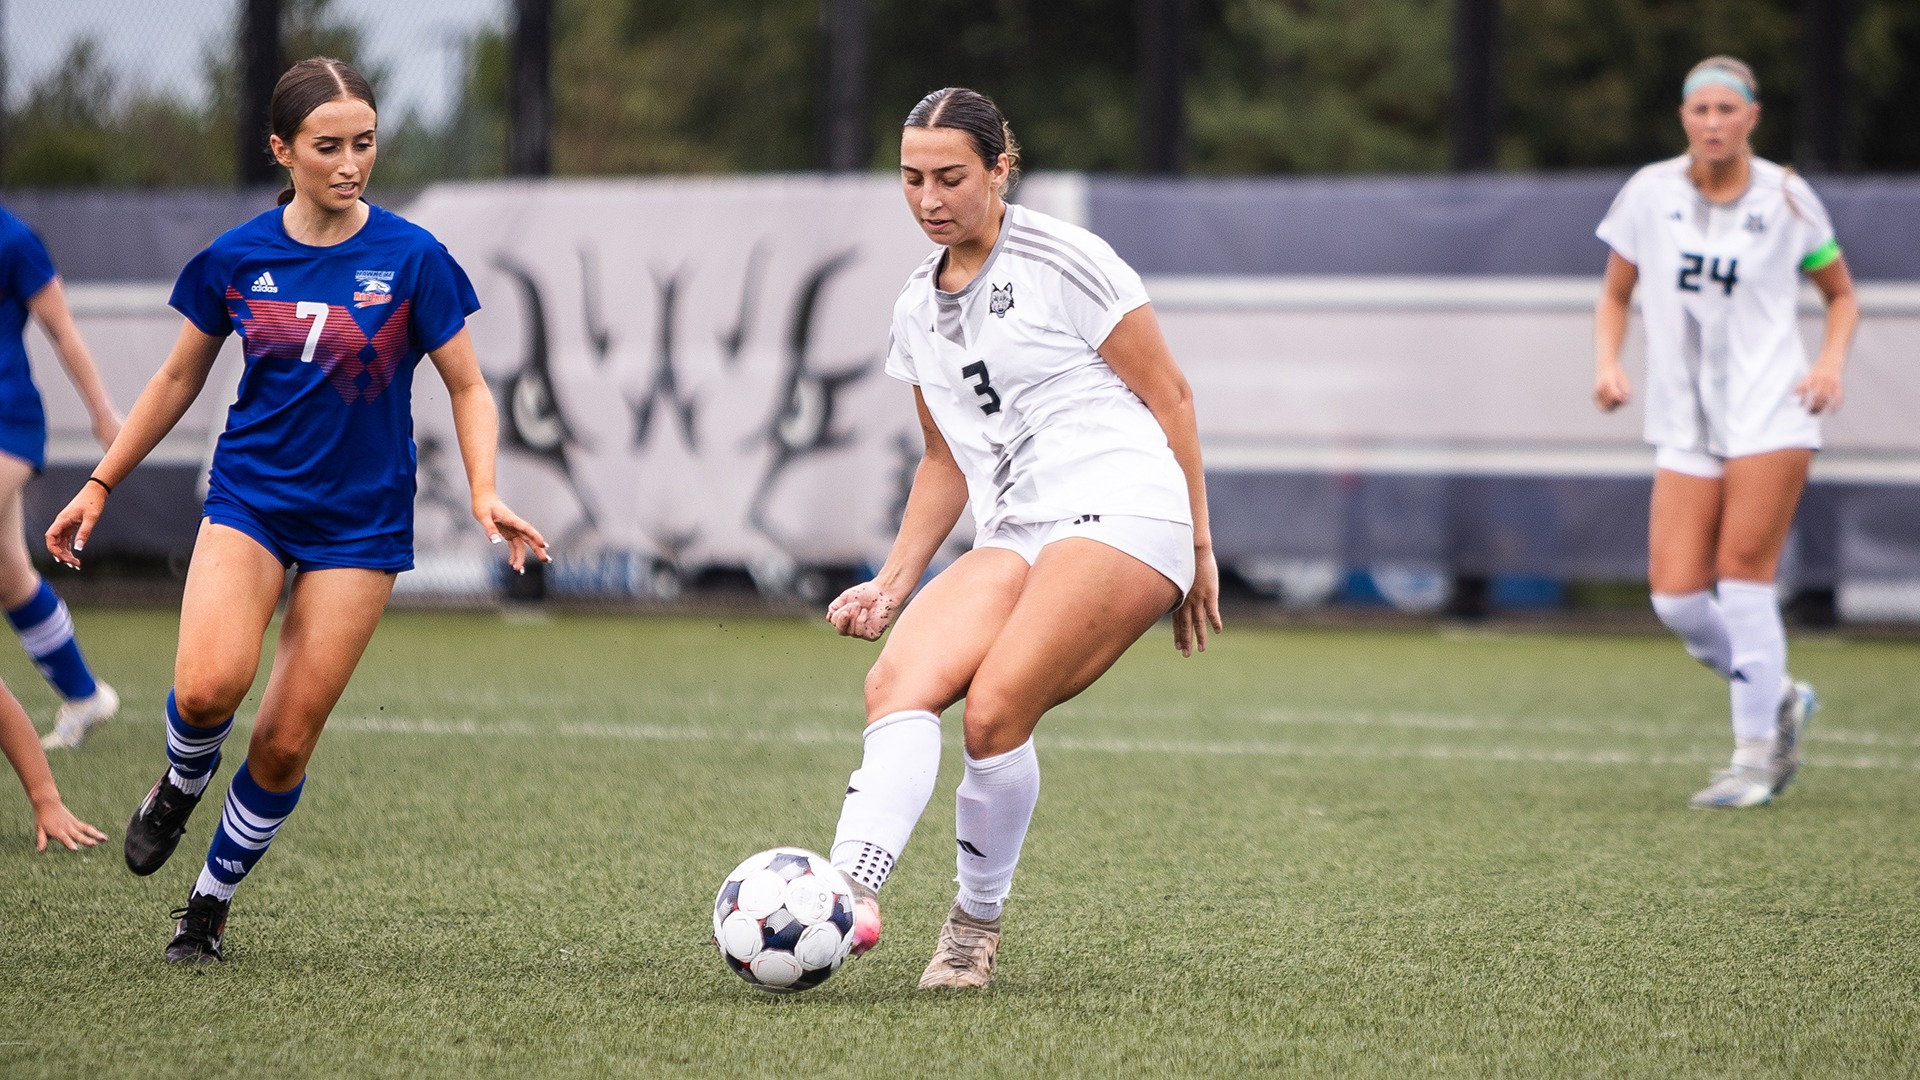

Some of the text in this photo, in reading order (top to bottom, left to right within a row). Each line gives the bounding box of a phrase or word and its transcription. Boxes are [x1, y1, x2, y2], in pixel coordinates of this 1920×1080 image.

[251, 285, 278, 293] adidas
[1679, 253, 1738, 296] 24
[296, 301, 329, 363] 7
[962, 360, 1001, 416] 3
